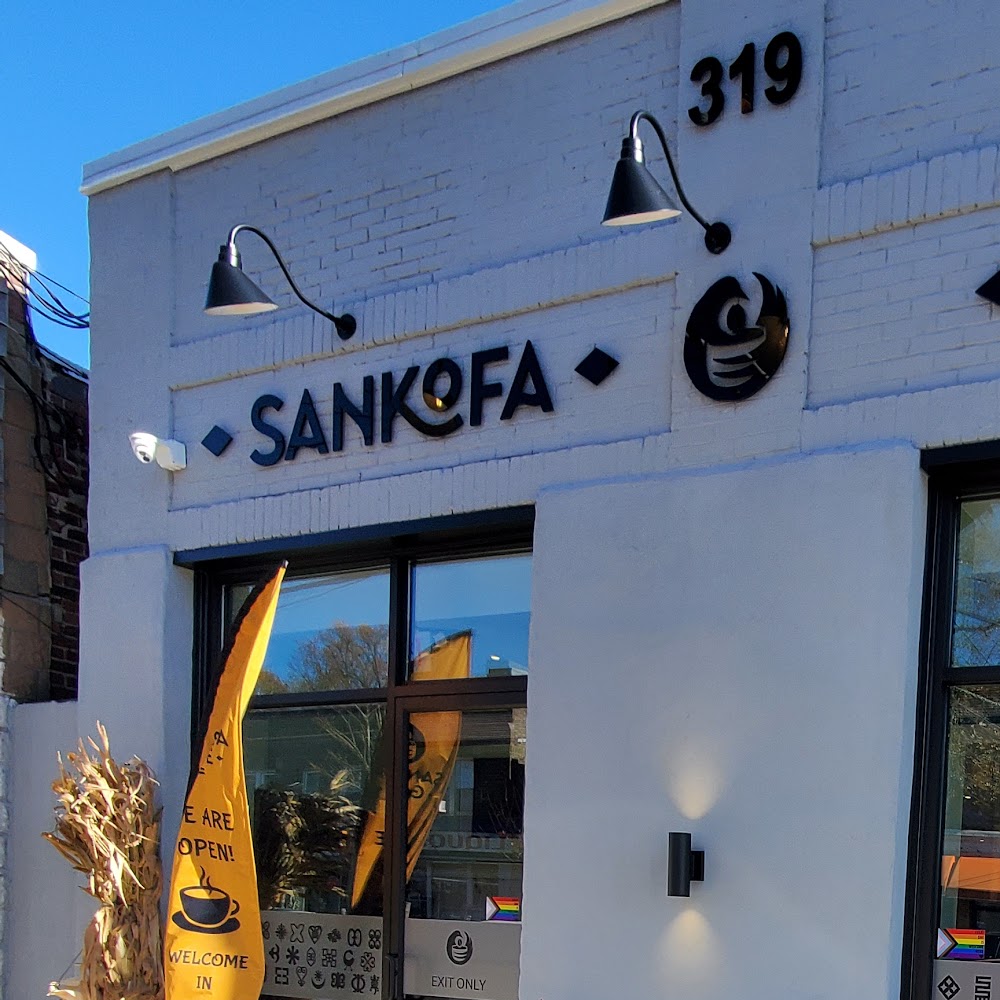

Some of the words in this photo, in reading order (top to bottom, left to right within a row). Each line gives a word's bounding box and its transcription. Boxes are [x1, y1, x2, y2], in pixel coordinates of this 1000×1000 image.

[688, 31, 802, 126] 319
[250, 340, 554, 466] SANKOFA
[202, 807, 234, 831] ARE
[178, 837, 235, 862] OPEN!
[169, 949, 249, 969] WELCOME
[196, 976, 213, 990] IN
[431, 975, 454, 988] EXIT
[456, 977, 487, 991] ONLY
